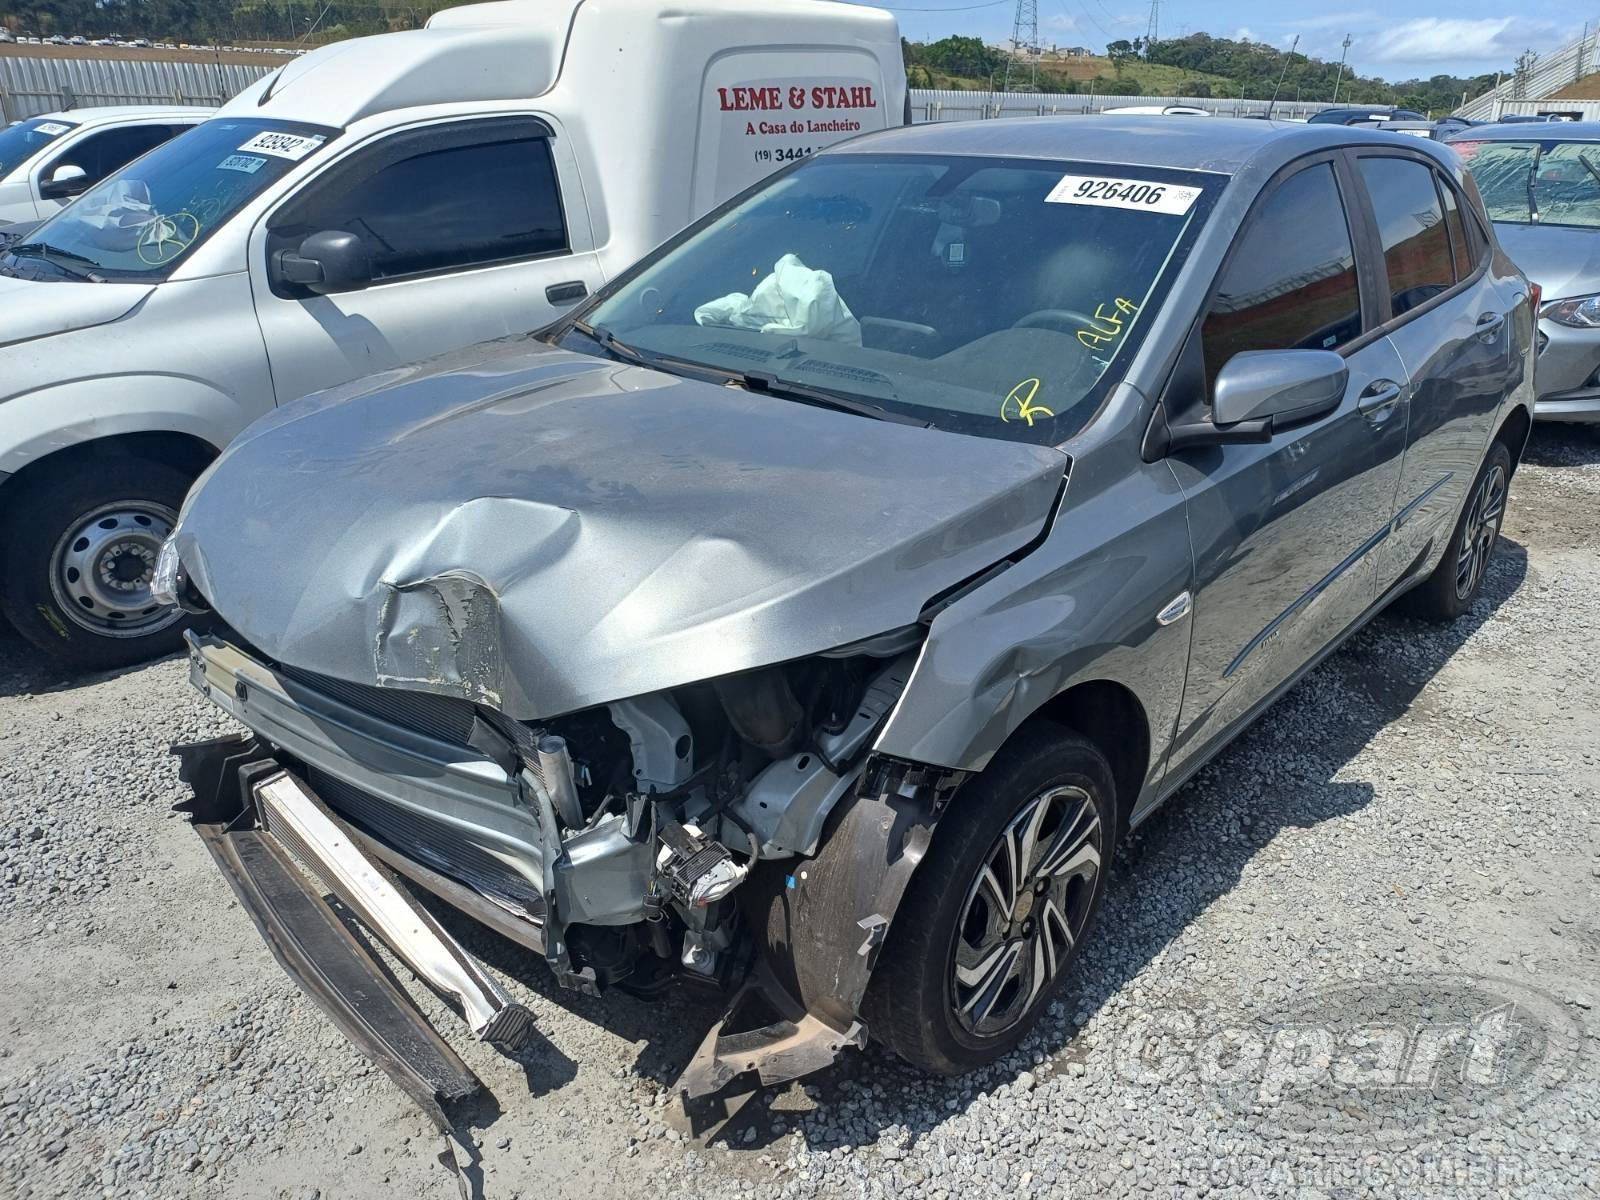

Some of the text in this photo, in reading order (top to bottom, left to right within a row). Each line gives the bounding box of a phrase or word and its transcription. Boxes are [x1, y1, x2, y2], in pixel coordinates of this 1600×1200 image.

[717, 86, 877, 111] LEME & STAHL
[745, 118, 861, 135] A Casa do Lancheiro
[754, 149, 772, 162] (19)
[1072, 180, 1167, 205] 926406
